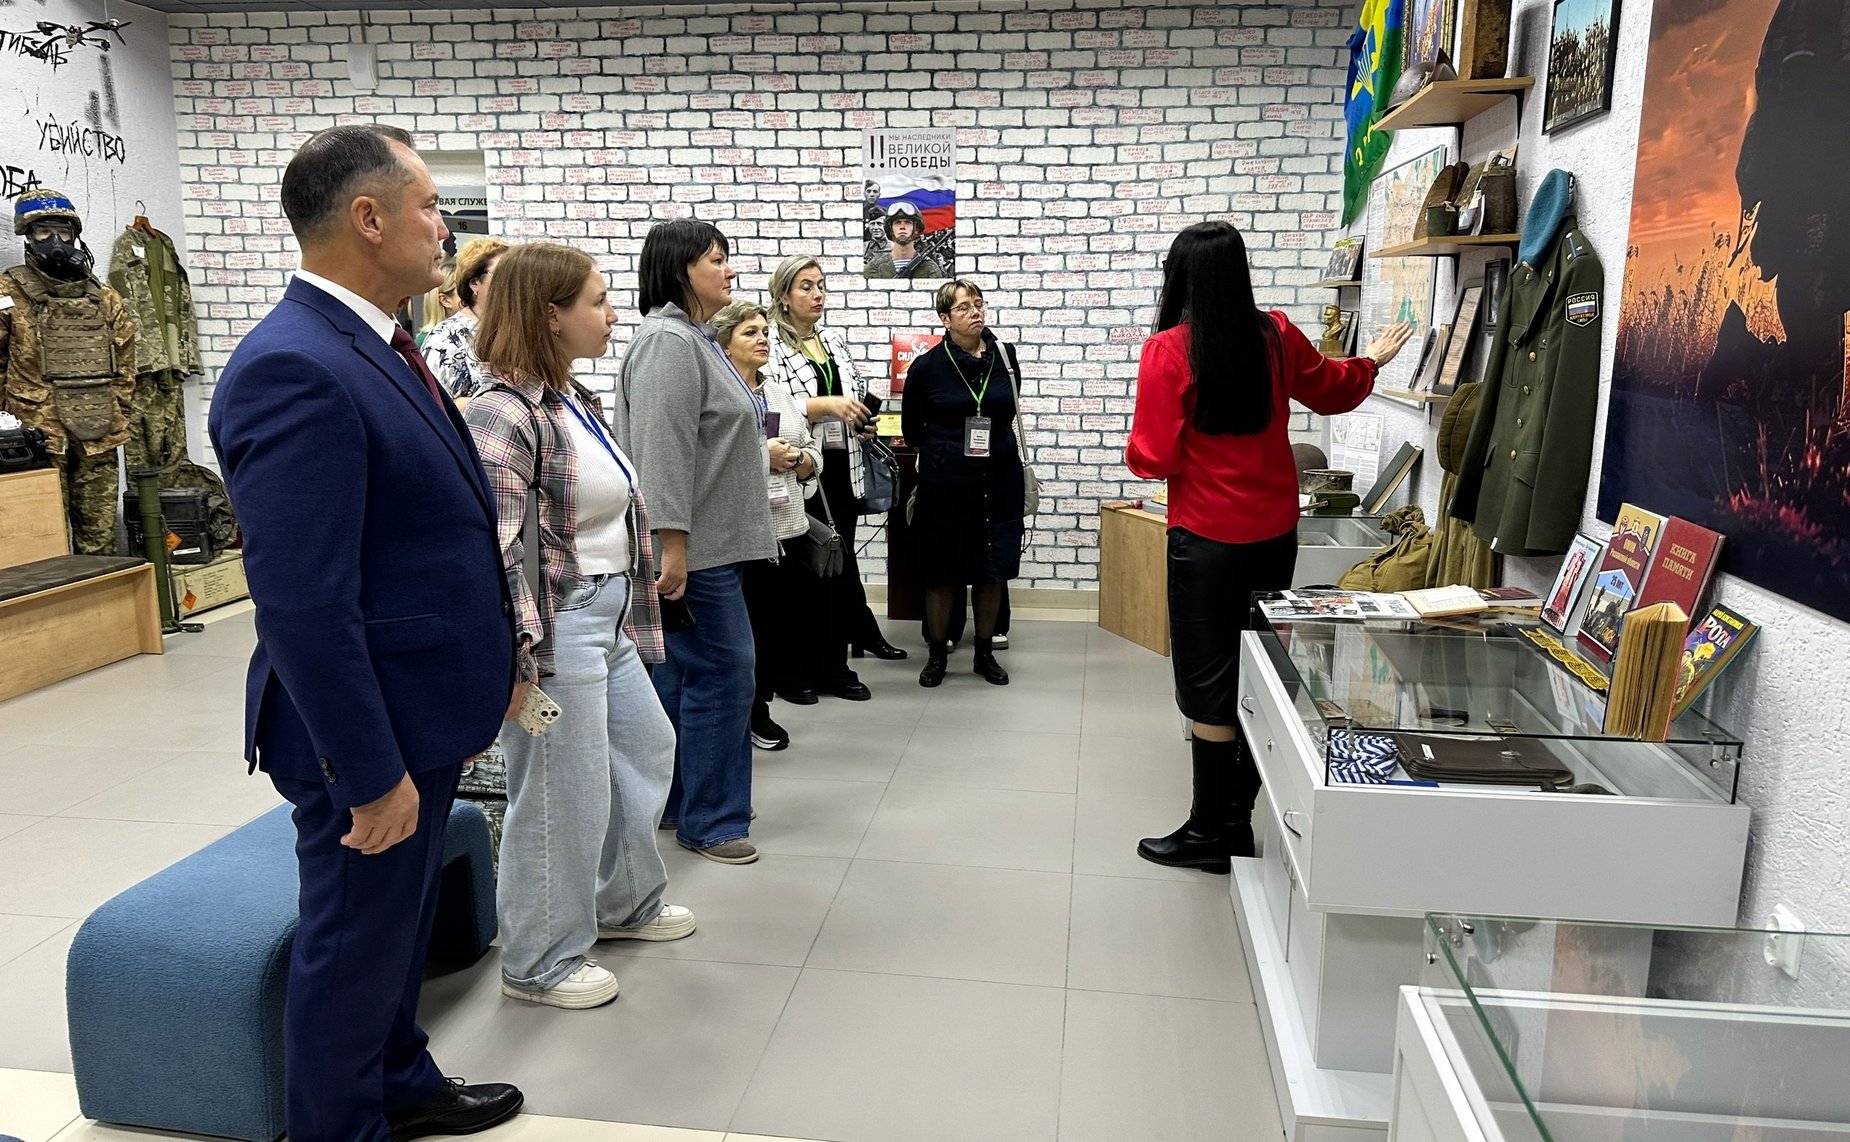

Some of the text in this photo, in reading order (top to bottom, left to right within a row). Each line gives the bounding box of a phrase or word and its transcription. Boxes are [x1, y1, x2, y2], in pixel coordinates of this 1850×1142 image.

[36, 113, 125, 164] УБИЙСТВО
[888, 141, 951, 155] ВЕЛИКОЙ
[888, 157, 951, 169] ПОБЕДЫ
[458, 221, 468, 230] 16
[1568, 294, 1595, 304] РОССИЯ
[1669, 543, 1697, 564] КНИГА
[1662, 557, 1694, 581] ПАМЯТИ
[1696, 614, 1732, 649] РОТА
